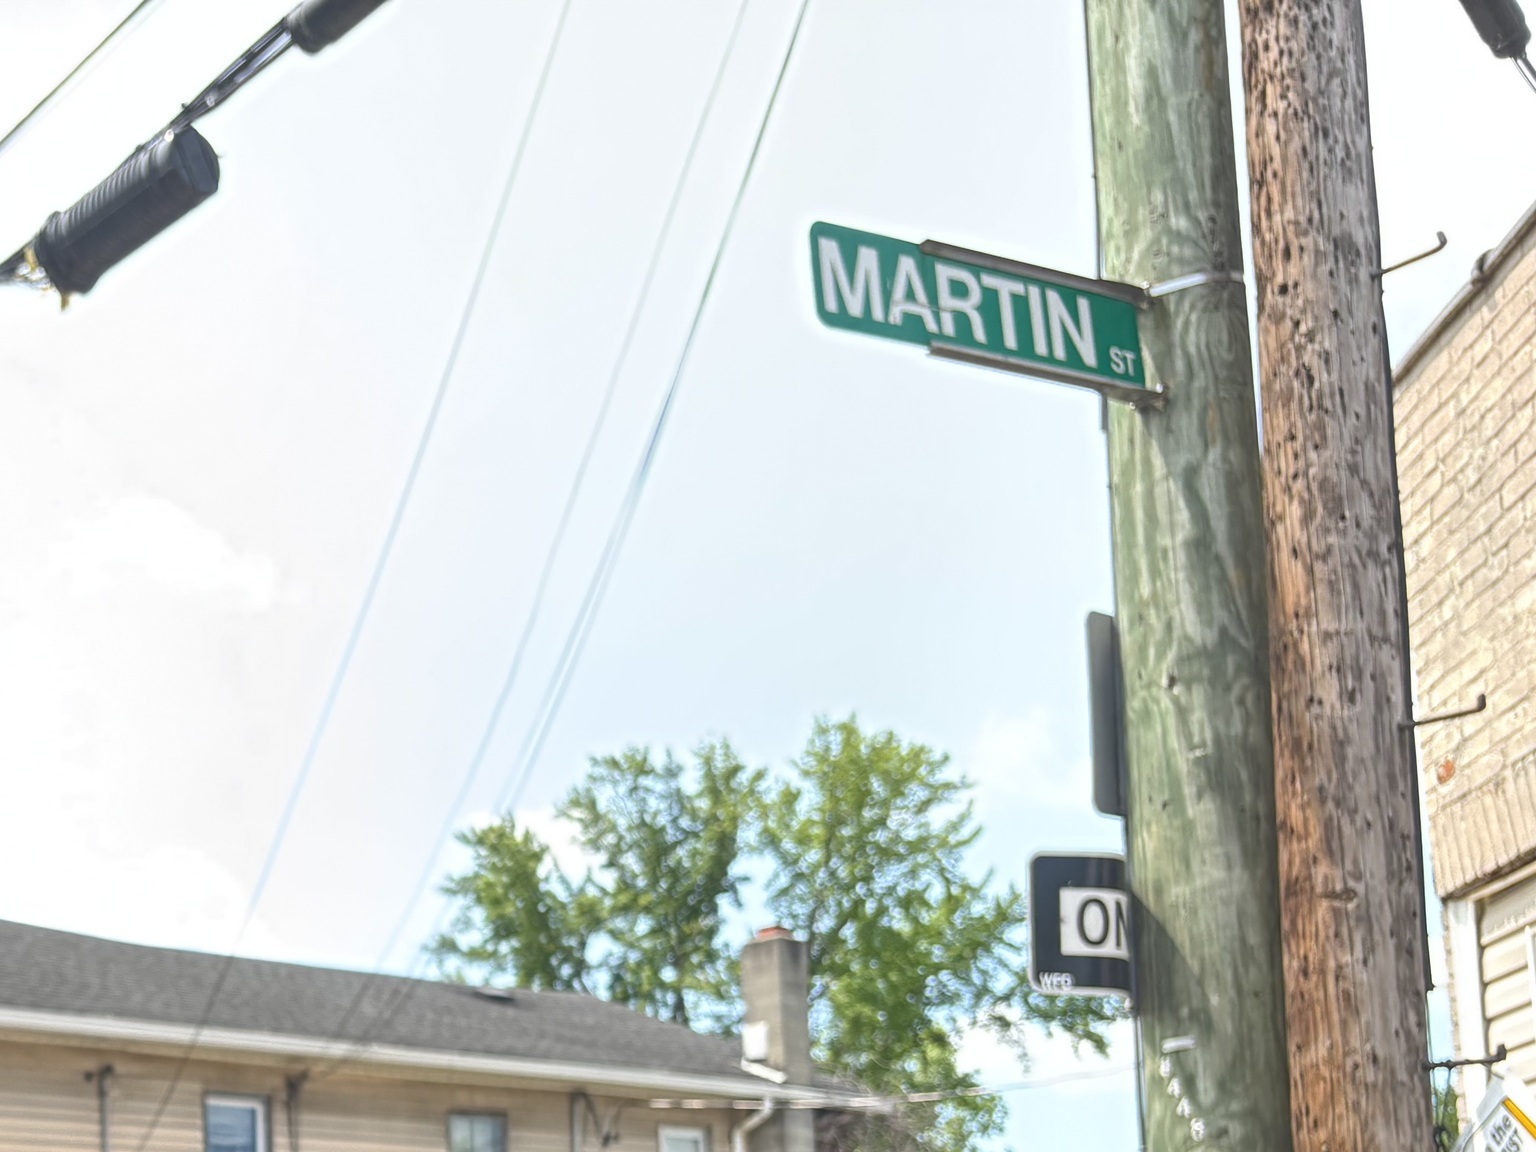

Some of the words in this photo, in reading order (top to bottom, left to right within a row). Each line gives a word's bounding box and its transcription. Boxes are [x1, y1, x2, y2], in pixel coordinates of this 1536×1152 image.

[817, 235, 1099, 369] MARTIN
[1109, 345, 1137, 378] ST
[1490, 1114, 1512, 1146] the
